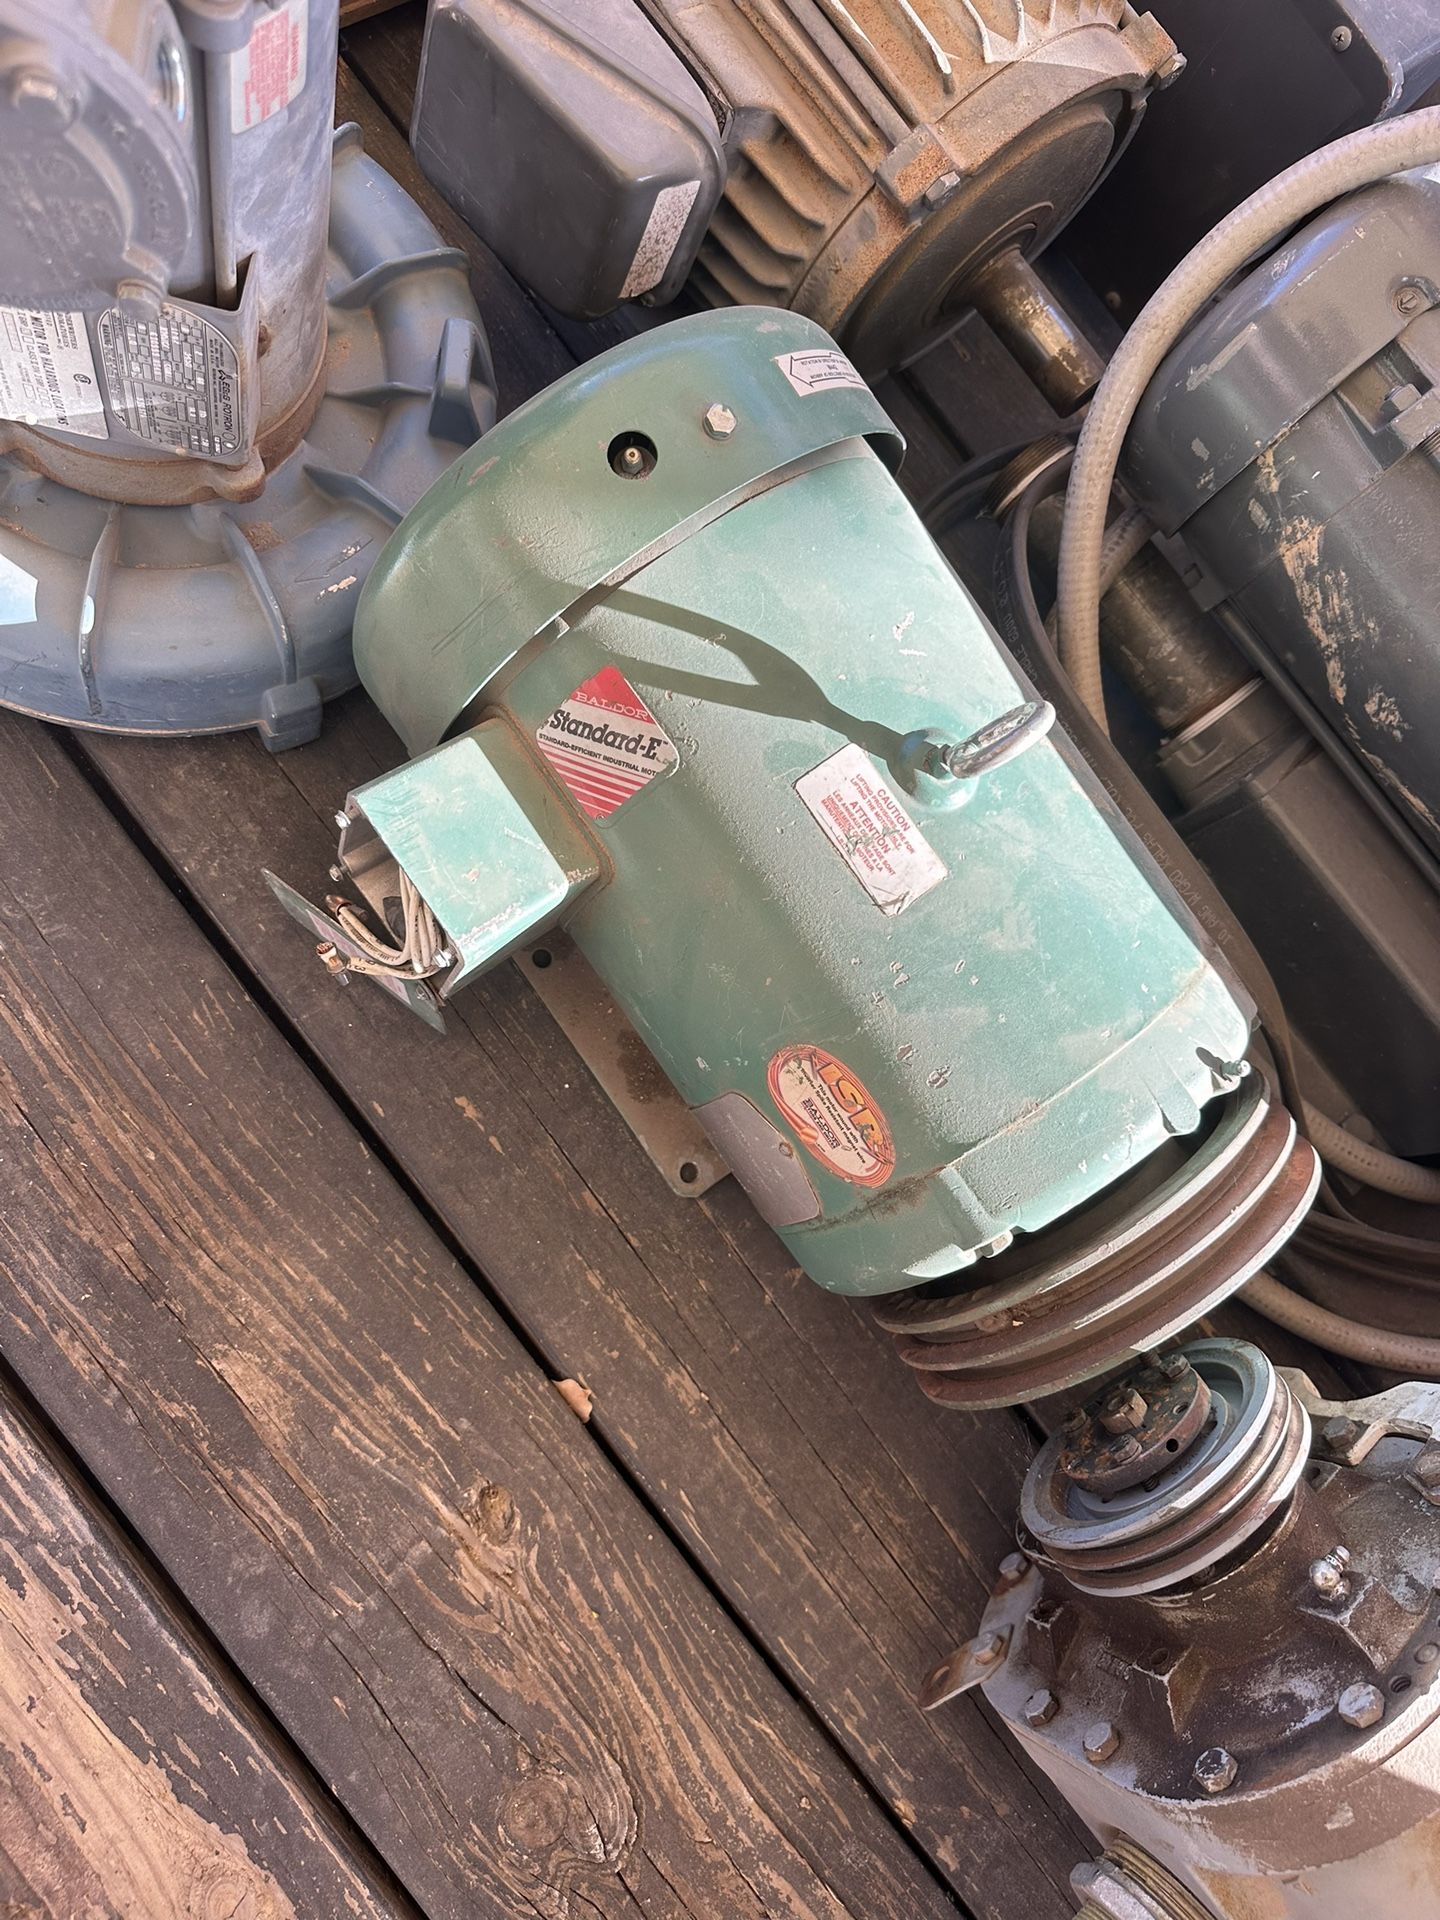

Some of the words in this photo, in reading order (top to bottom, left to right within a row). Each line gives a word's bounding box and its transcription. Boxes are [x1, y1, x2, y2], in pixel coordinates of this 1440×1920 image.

[30, 316, 46, 339] MOTOR
[36, 342, 50, 354] FOR
[40, 357, 60, 393] HAZARDOUS
[221, 381, 230, 401] EG&G
[222, 402, 232, 431] ROTRON
[574, 691, 648, 720] BALDOR
[538, 732, 601, 759] STANDARD-EFFICIENT
[602, 754, 640, 772] INDUSTRIAL
[549, 708, 662, 760] Standard-E
[849, 799, 891, 853] ATTENTION
[850, 778, 867, 799] LIFTING
[866, 799, 875, 811] THE
[874, 811, 891, 833] MOTO
[855, 774, 872, 795] LIFTING
[871, 795, 896, 829] PROVISIONS
[904, 841, 914, 854] FOR
[876, 788, 910, 831] CAUTION
[827, 795, 853, 830] UNIQUEMENT
[875, 863, 882, 871] LA
[833, 791, 842, 802] LES
[841, 802, 861, 828] ANNEAUX
[882, 860, 894, 875] SONT
[804, 1098, 840, 1147] BALDOR
[814, 1090, 826, 1106] Spike
[825, 1105, 843, 1131] Resistant
[842, 1131, 857, 1151] magnet
[856, 1152, 865, 1163] wire
[818, 1084, 826, 1096] This
[825, 1096, 837, 1112] motor
[836, 1113, 850, 1131] wound
[849, 1131, 858, 1143] with
